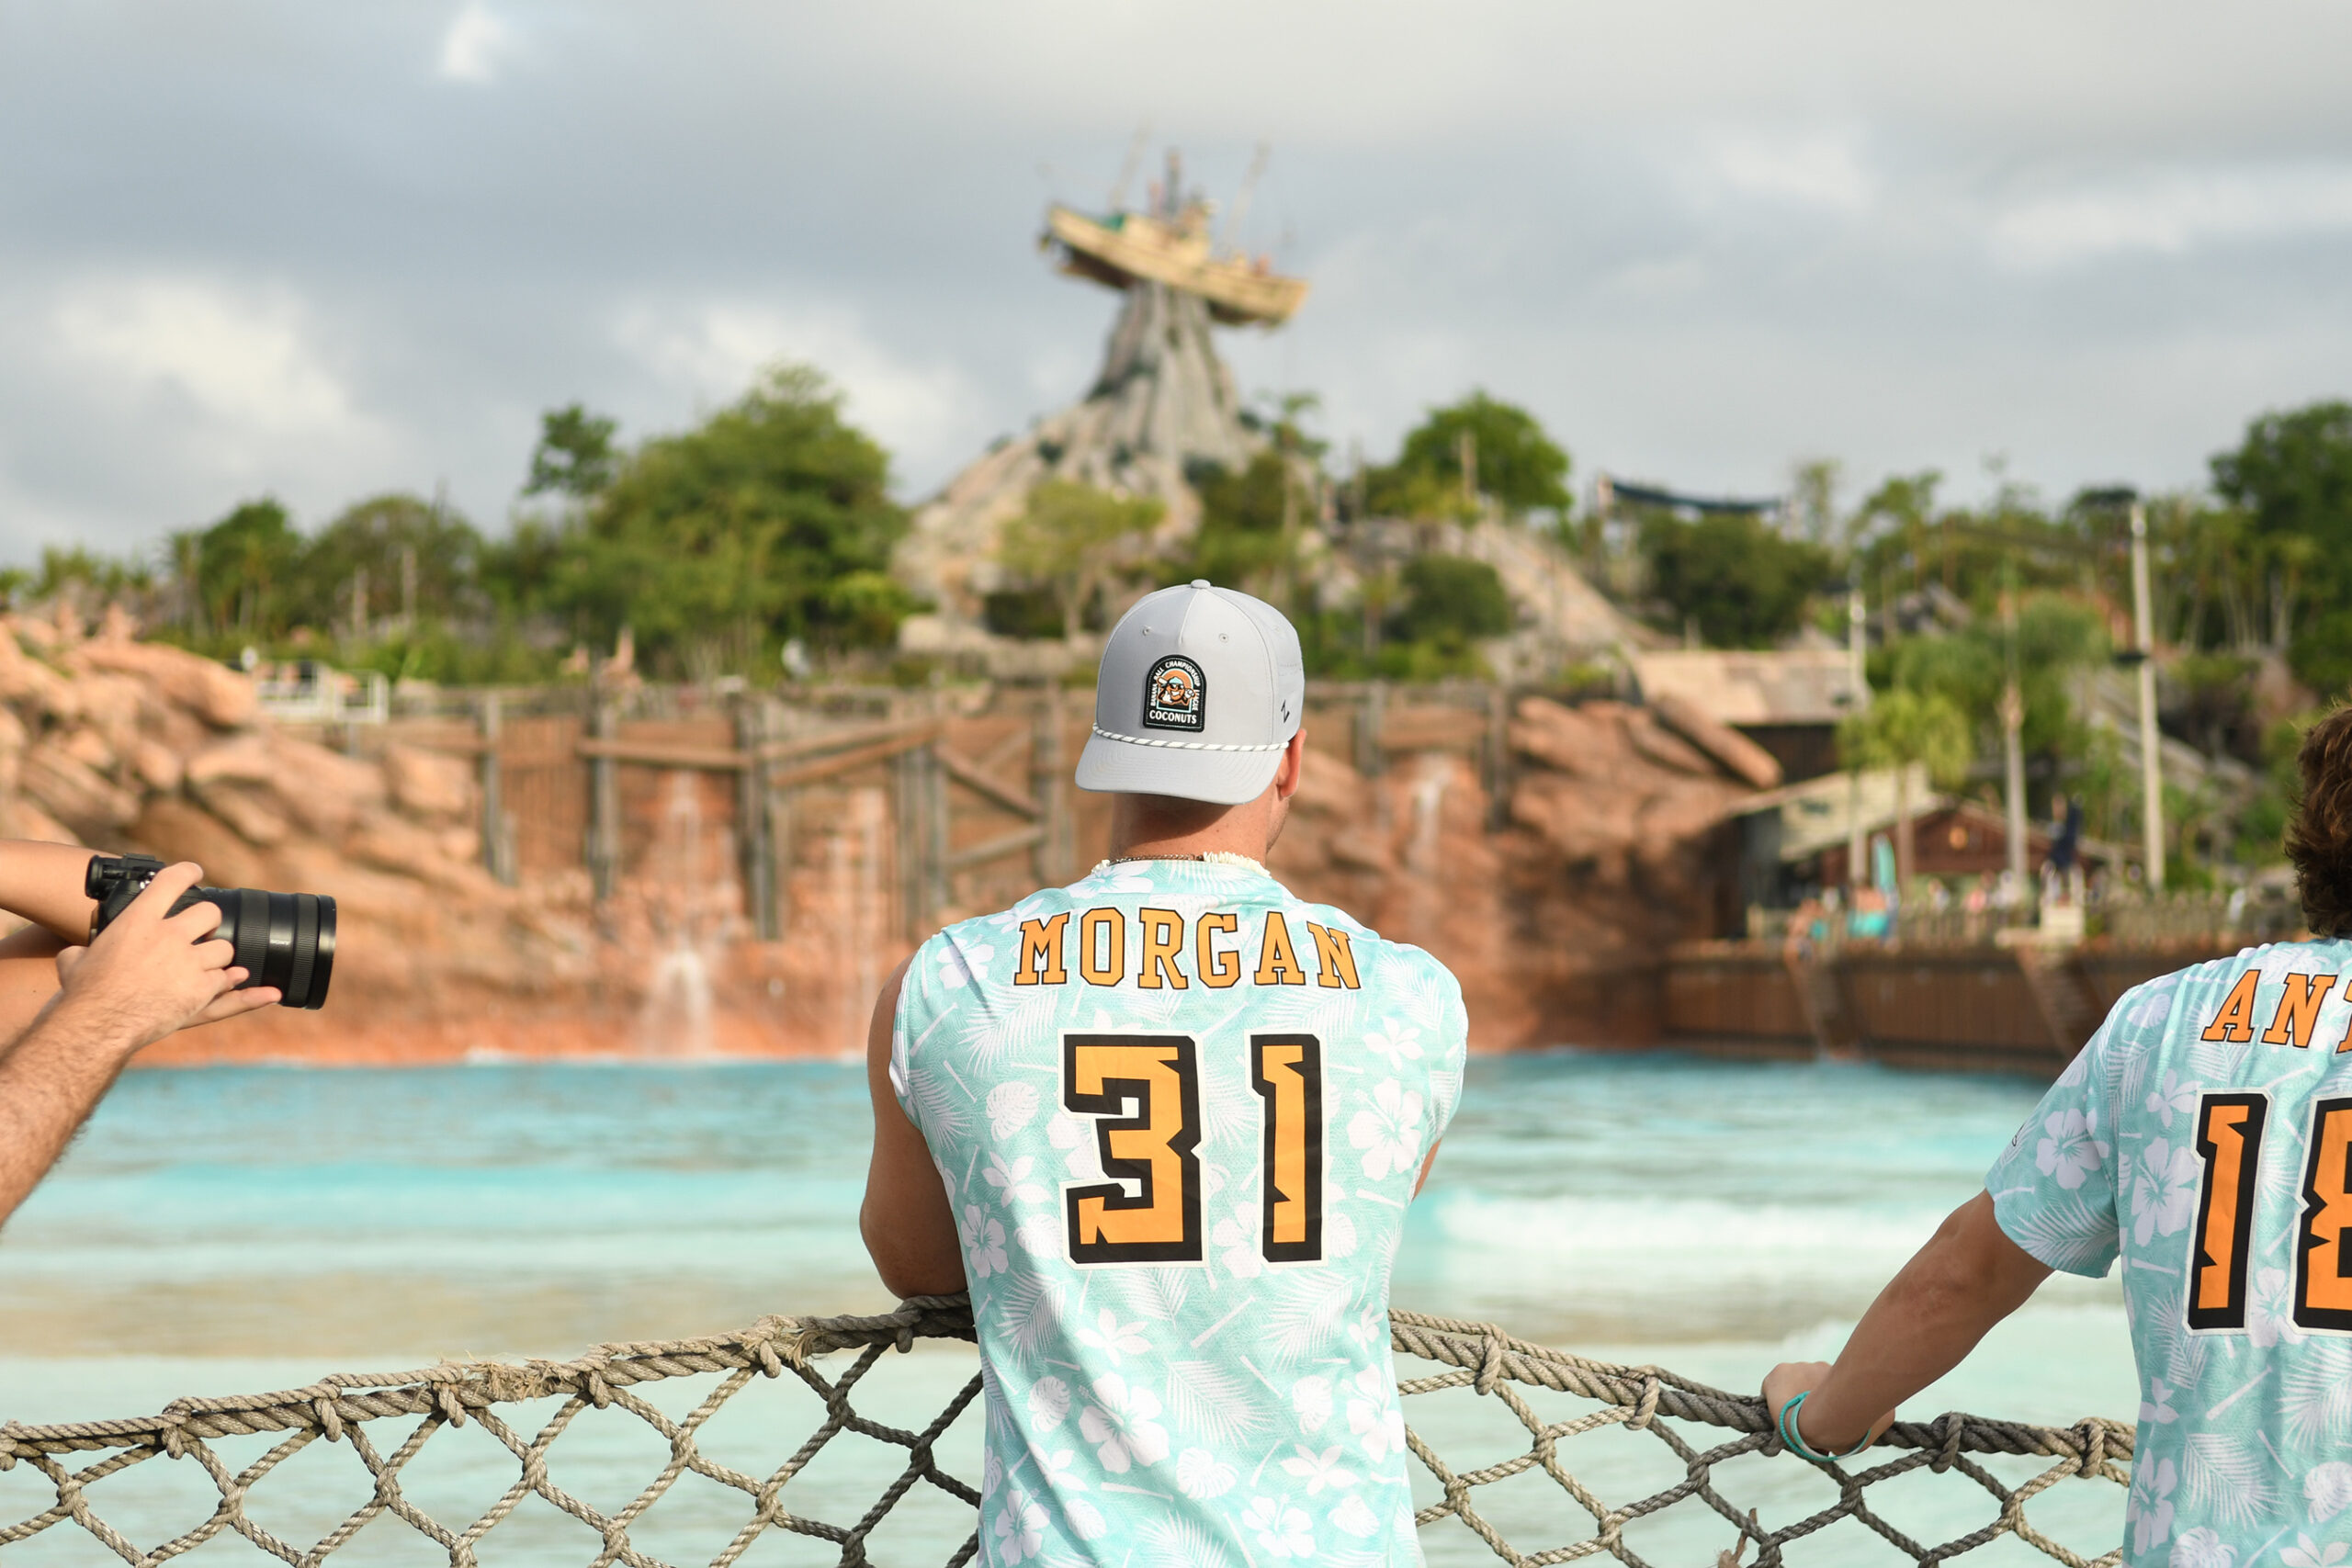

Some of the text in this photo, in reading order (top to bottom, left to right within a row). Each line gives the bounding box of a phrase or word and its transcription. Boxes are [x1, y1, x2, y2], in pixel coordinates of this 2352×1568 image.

[1165, 660, 1201, 687] CHAMPIONSHIP
[1149, 710, 1197, 724] COCONUTS
[1014, 907, 1362, 989] MORGAN
[2200, 969, 2352, 1055] AN
[1062, 1032, 1325, 1266] 31
